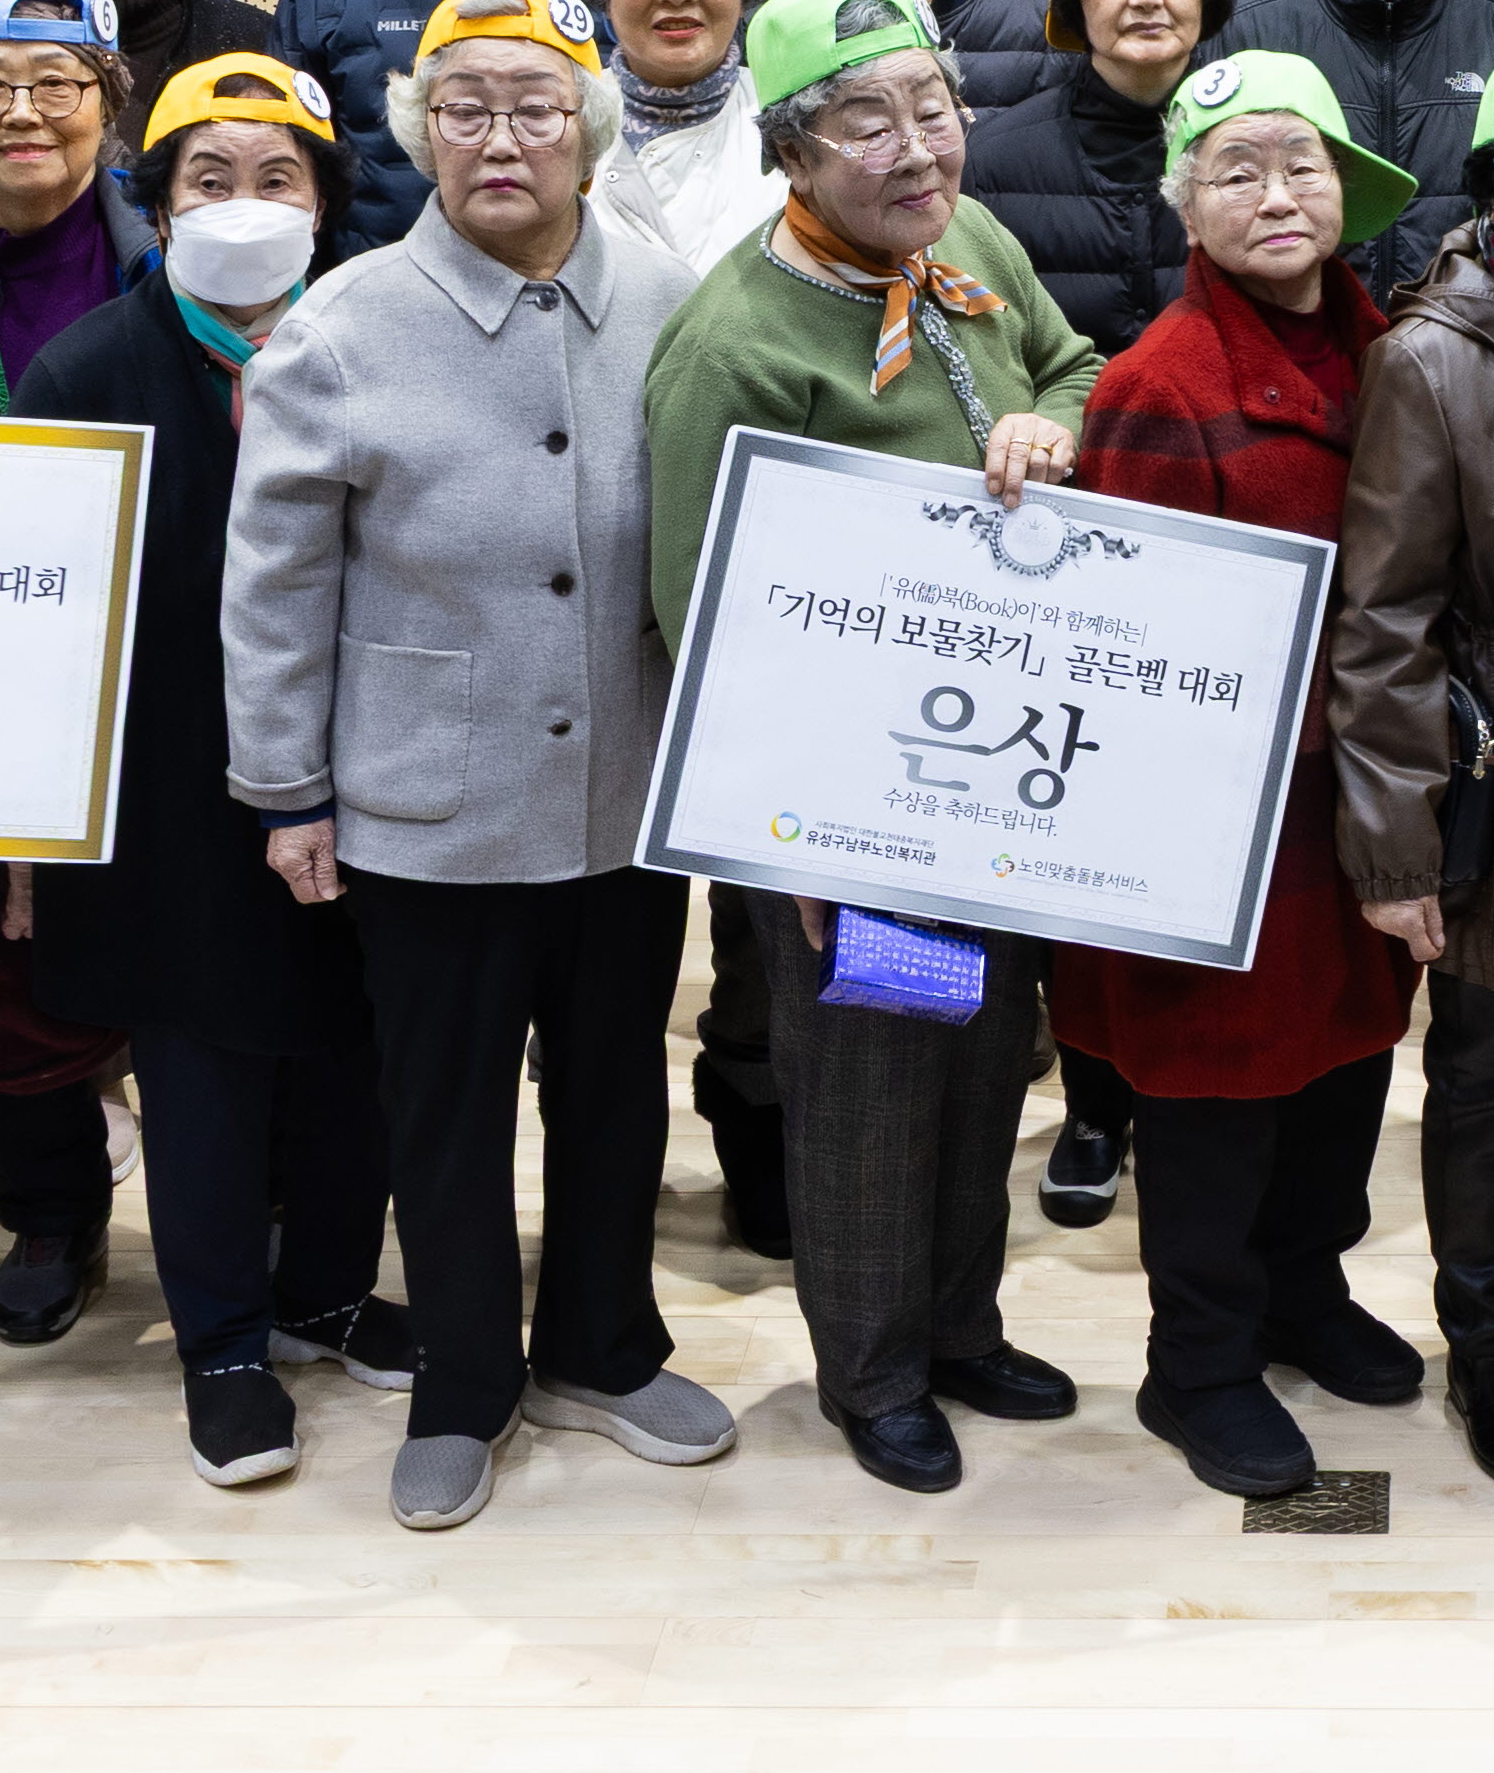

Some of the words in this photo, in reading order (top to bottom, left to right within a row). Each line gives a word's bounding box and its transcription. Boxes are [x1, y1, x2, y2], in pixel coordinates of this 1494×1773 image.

[1204, 69, 1226, 95] 3
[1066, 610, 1142, 644] 함께하는
[767, 584, 887, 645] 「기억의
[892, 613, 1046, 680] 보물찾기」
[1064, 644, 1168, 700] 골든벨
[1178, 666, 1245, 713] 대회
[887, 685, 1100, 810] 은상
[882, 786, 941, 818] 수상을
[943, 797, 1058, 839] 축하드립니다.
[806, 830, 937, 866] 유성구남부노인복지관
[1018, 857, 1149, 893] 노인맞춤돌봄서비스
